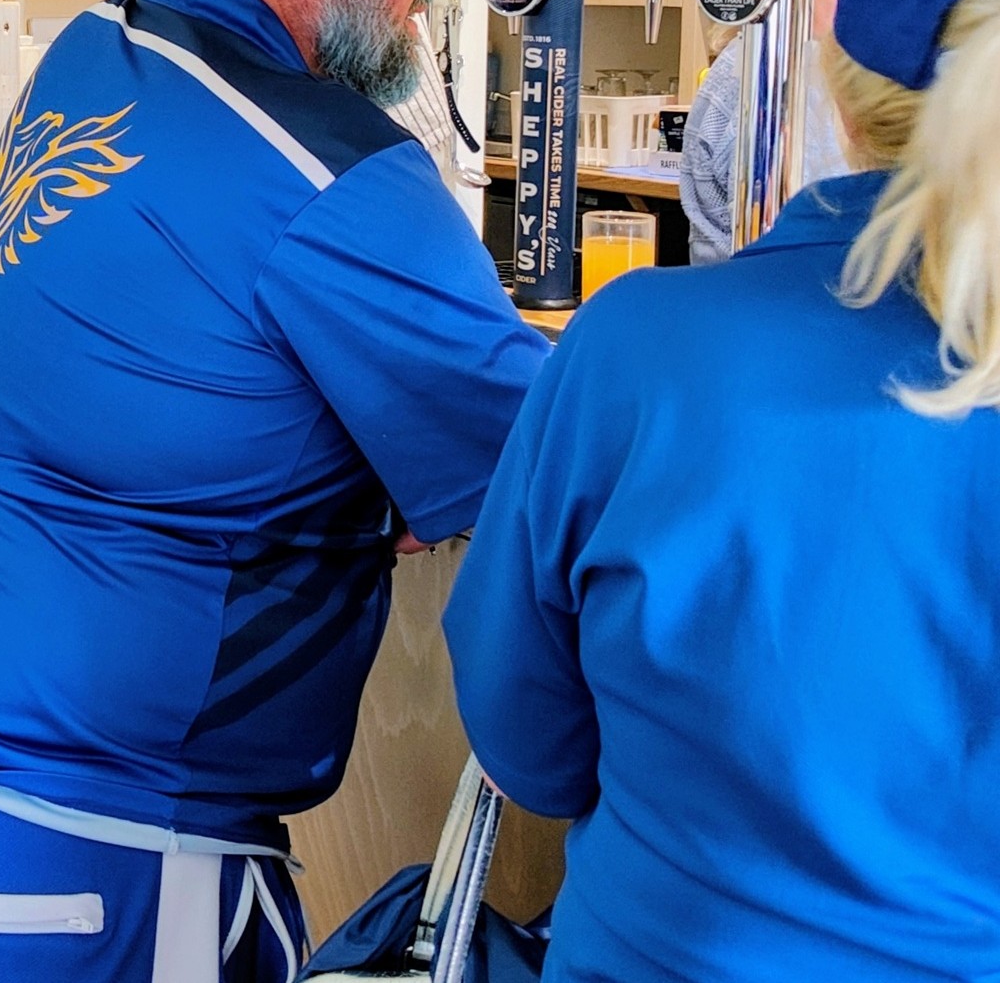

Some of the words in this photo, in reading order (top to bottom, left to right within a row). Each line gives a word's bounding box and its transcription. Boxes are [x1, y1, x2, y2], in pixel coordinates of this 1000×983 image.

[553, 48, 567, 83] REAL
[552, 85, 565, 127] CIDER
[517, 47, 543, 271] SHEPPY'S
[551, 129, 564, 173] TAKES
[660, 159, 681, 170] RAFFL
[549, 175, 562, 208] TIME
[515, 274, 537, 285] CIDER
